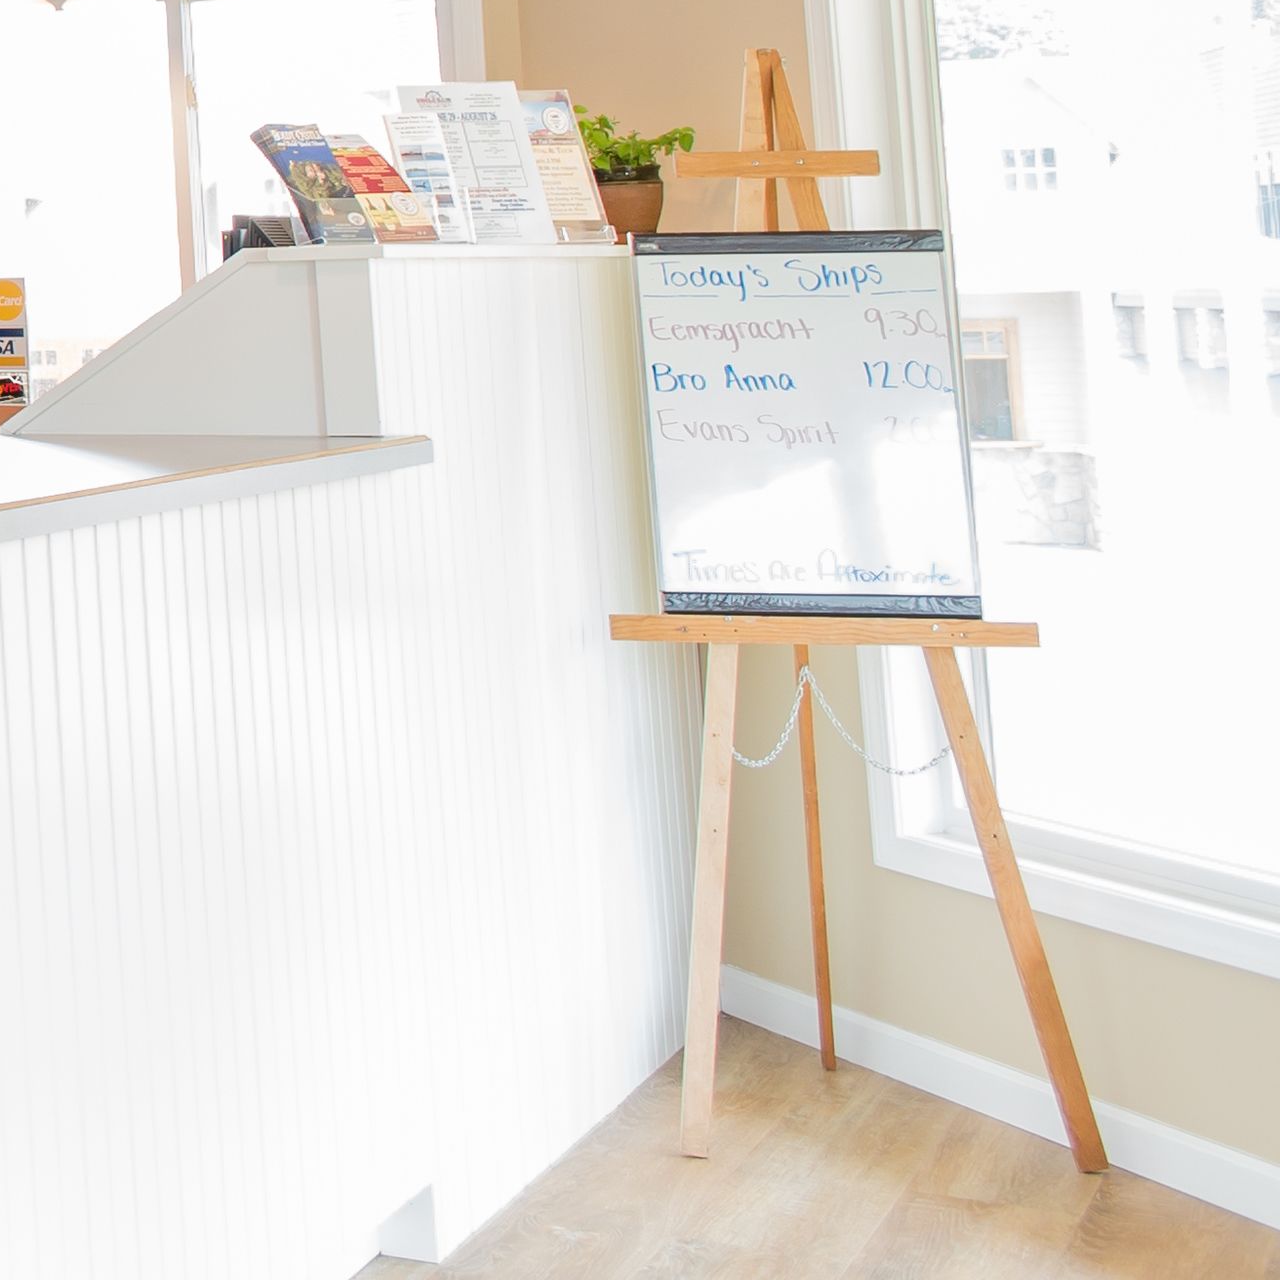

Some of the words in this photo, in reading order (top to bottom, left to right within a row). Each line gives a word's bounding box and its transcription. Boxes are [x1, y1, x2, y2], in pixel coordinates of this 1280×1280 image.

[650, 260, 769, 302] Today's
[784, 259, 883, 294] Ships
[648, 316, 815, 353] Eemsgracht
[651, 363, 706, 392] Bro
[724, 363, 797, 392] Anna
[656, 408, 750, 443] Evans
[757, 414, 840, 449] Spirit
